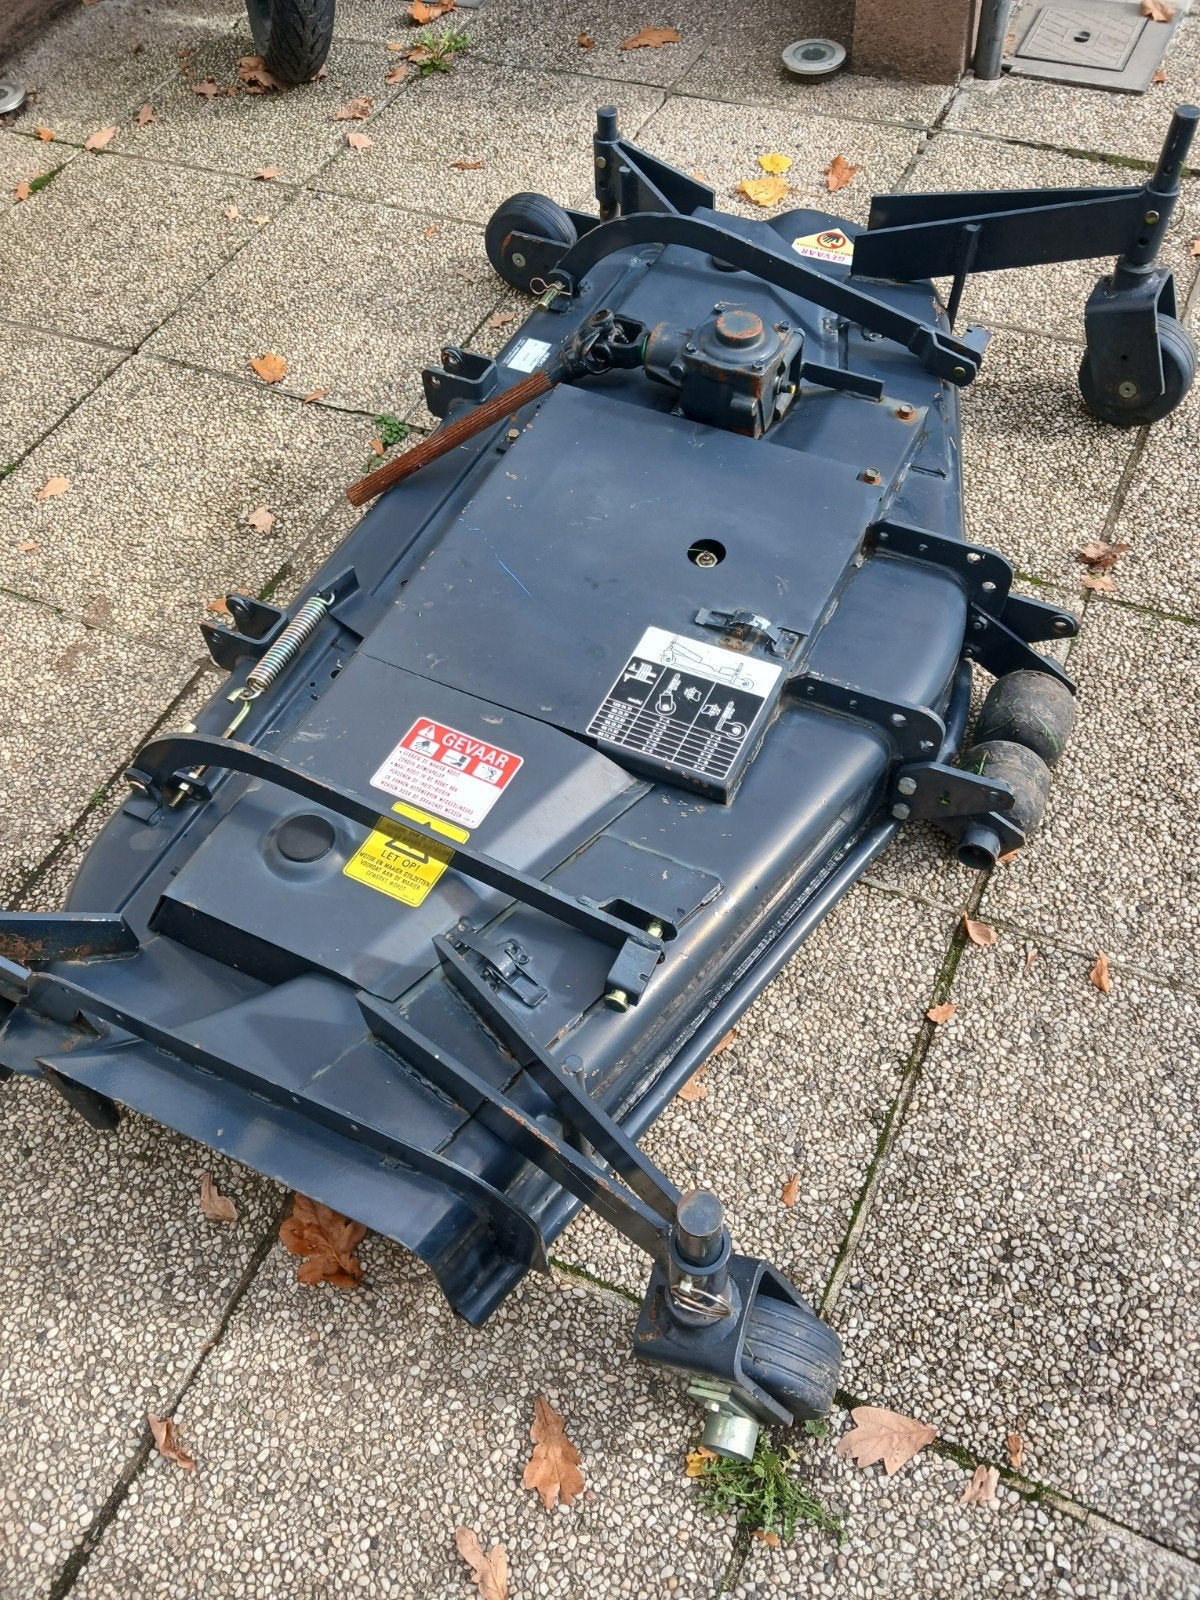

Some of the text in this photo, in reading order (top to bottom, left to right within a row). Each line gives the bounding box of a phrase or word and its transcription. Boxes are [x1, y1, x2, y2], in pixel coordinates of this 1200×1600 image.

[801, 248, 845, 261] GEVAAR
[442, 733, 509, 768] GEVAAR
[359, 852, 376, 861] MOTOR
[384, 863, 403, 875] MAAIER
[360, 860, 382, 871] VOORDAT
[382, 869, 394, 877] AAN
[381, 850, 420, 871] LET OP!
